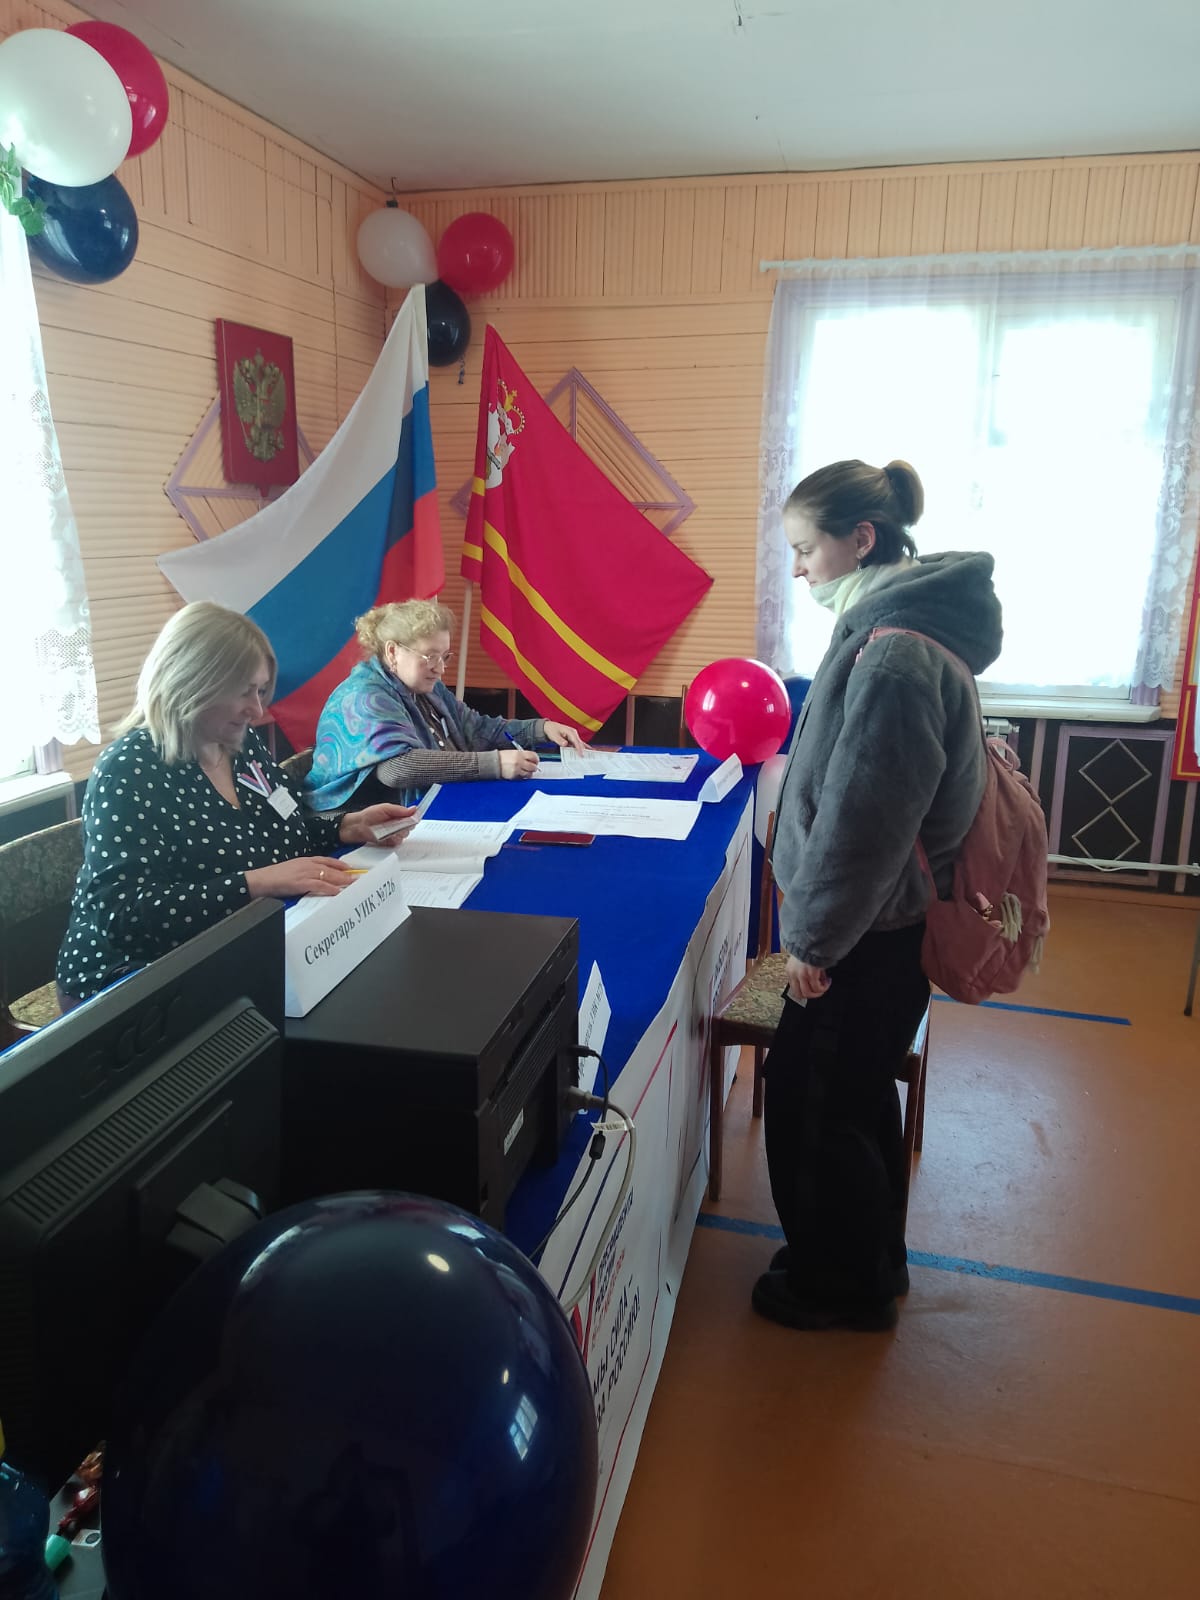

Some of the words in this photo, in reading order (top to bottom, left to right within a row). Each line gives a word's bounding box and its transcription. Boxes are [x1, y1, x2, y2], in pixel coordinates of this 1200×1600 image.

[304, 917, 355, 965] Секретарь
[354, 895, 376, 923] УИК
[376, 879, 396, 905] №726
[594, 1344, 608, 1396] МЫ
[610, 1286, 627, 1358] СИЛА
[608, 1286, 640, 1401] РОССИЮ!
